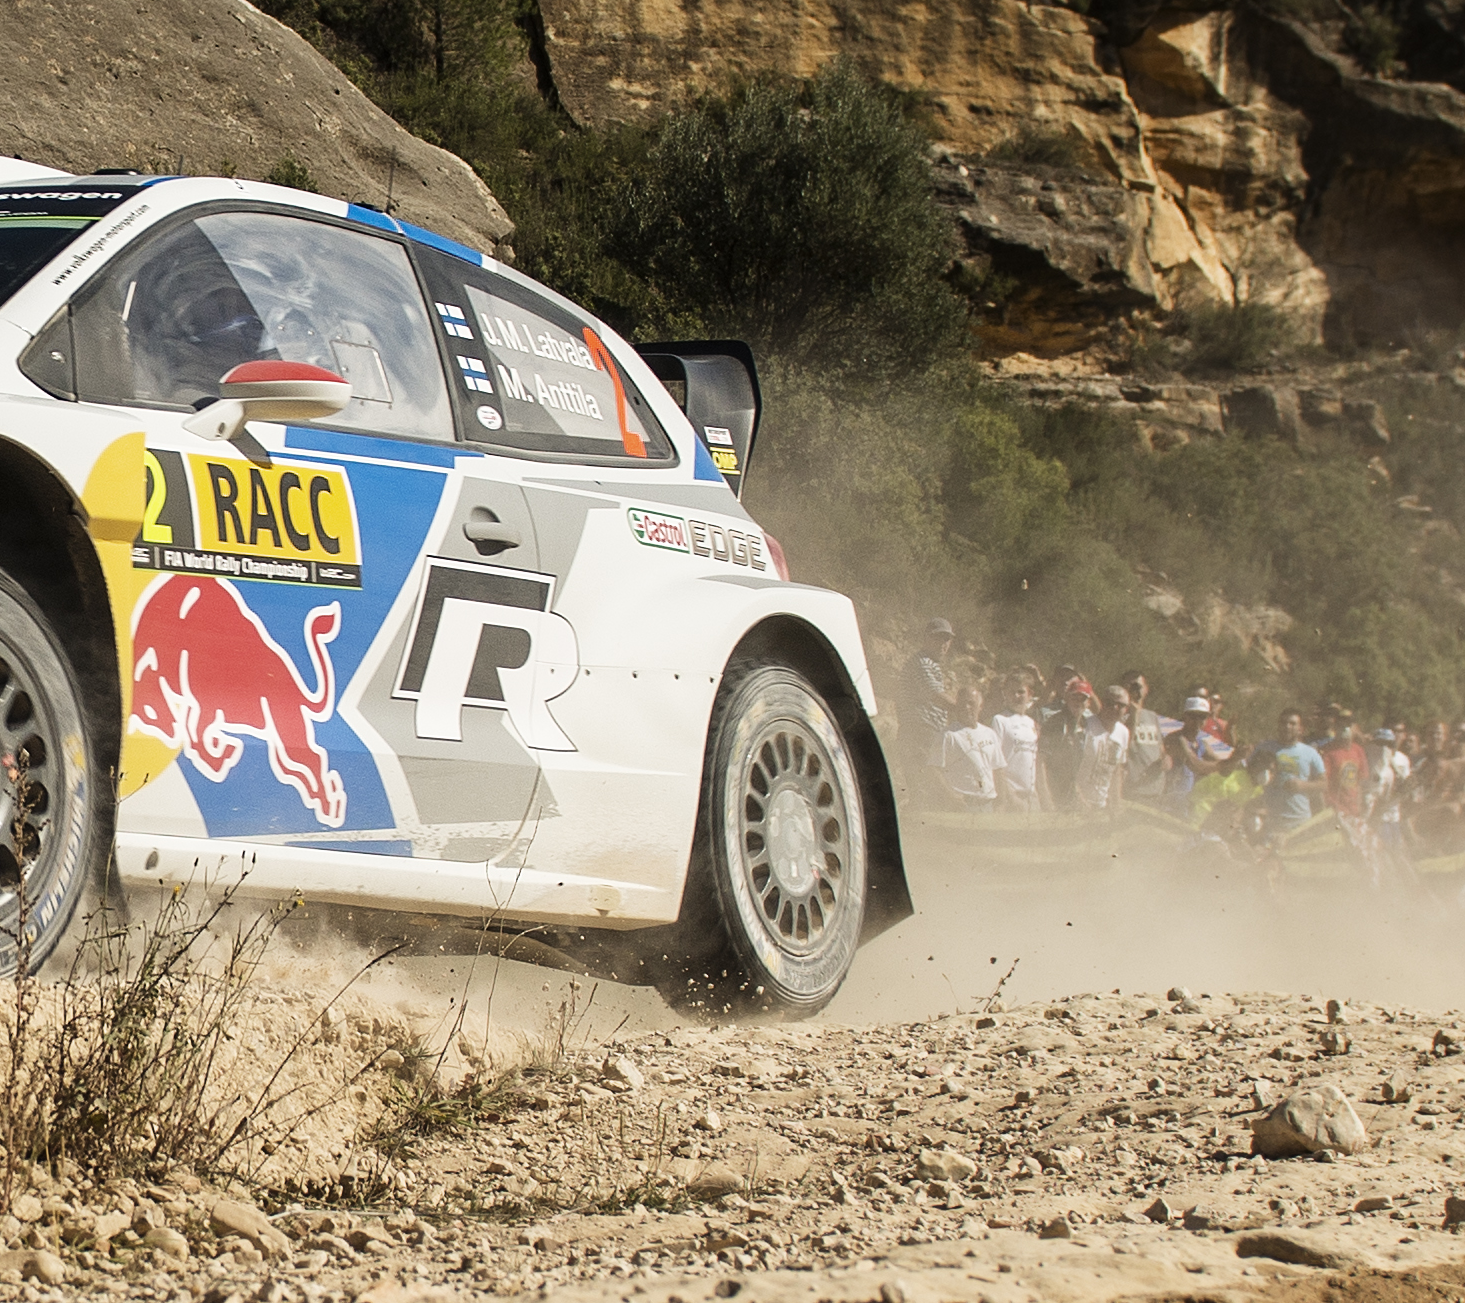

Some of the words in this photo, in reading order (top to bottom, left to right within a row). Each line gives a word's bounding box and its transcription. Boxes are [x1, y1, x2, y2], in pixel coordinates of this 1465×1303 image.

[522, 323, 598, 372] Latvala
[497, 364, 534, 403] M.
[533, 373, 604, 421] Anttila
[582, 326, 648, 459] 2
[206, 462, 341, 555] RACC
[164, 550, 184, 567] FIA
[184, 553, 214, 570] World
[215, 557, 241, 576] Rally
[241, 558, 309, 581] Championship
[644, 515, 687, 547] Castrol
[688, 519, 767, 572] EDGE
[390, 554, 580, 753] R
